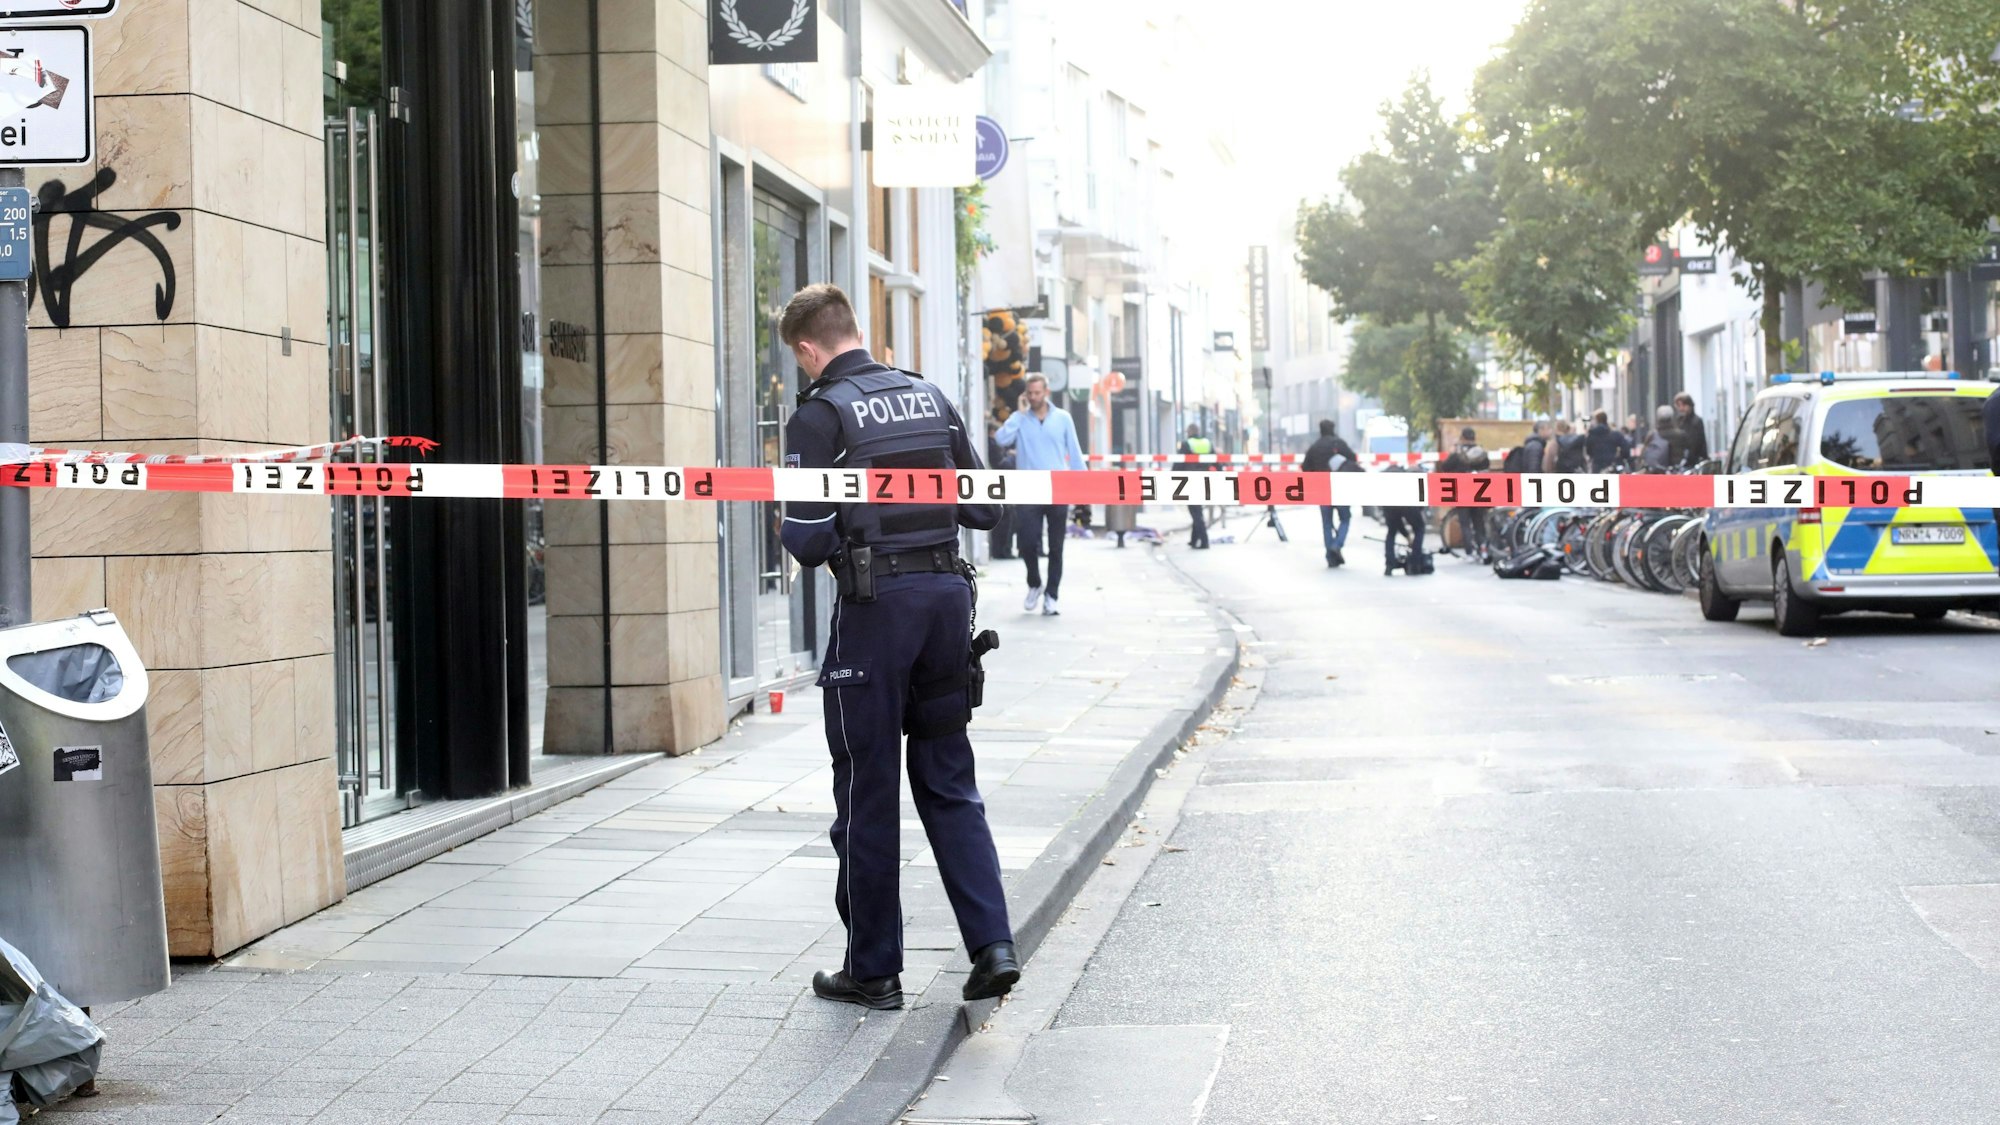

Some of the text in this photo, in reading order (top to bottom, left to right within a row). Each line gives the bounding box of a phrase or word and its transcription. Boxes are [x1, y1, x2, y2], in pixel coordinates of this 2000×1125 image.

[887, 115, 960, 127] SCOTCH
[909, 132, 960, 144] SODA
[3, 207, 27, 221] 200
[10, 228, 27, 241] 1,5
[851, 392, 941, 429] POLIZEI
[245, 465, 423, 492] POLIZEI
[531, 469, 713, 497] POLIZEI
[822, 473, 1006, 500] POLIZEI
[1118, 475, 1304, 501] POLIZEI
[1418, 477, 1609, 503] POLIZEI
[1727, 479, 1923, 505] POLIZEI
[1937, 528, 1964, 540] 7009
[829, 668, 852, 682] POLIZEI
